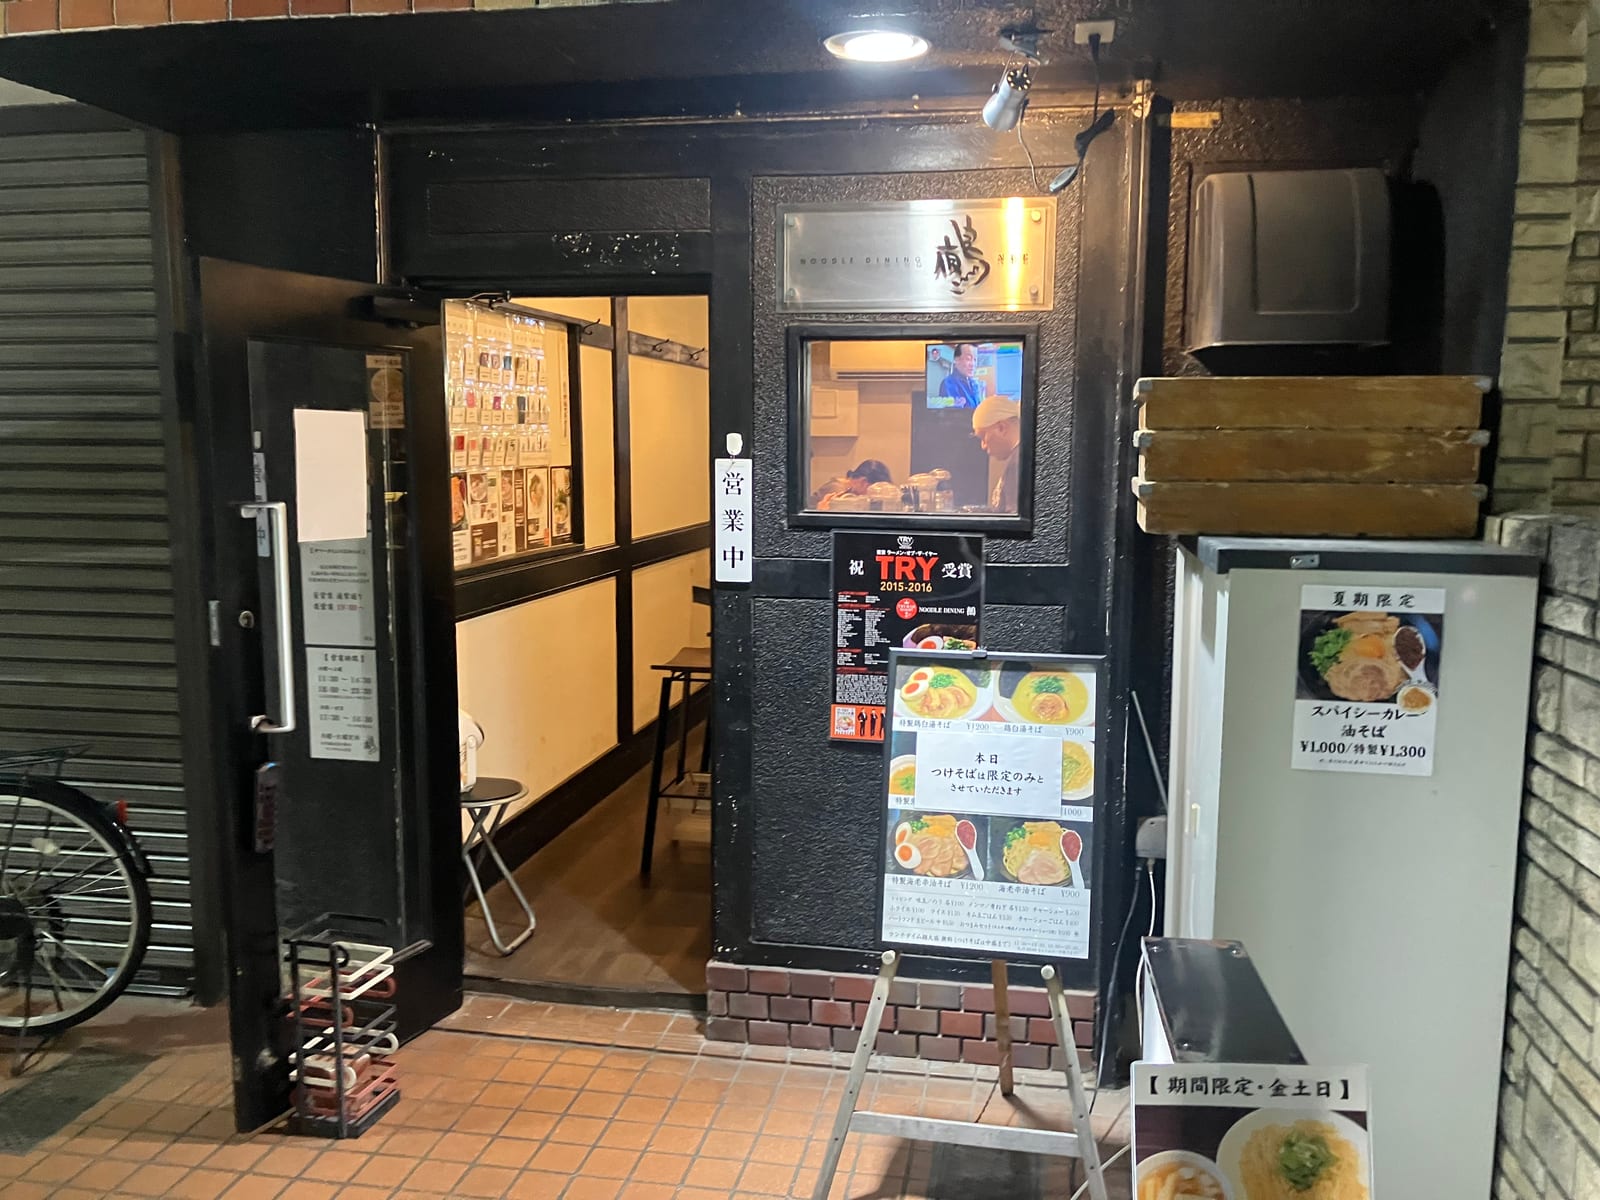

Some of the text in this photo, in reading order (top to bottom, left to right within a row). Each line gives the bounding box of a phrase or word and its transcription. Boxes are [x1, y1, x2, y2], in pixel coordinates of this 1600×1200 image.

[800, 257, 855, 265] NOODLE
[865, 256, 922, 265] DINING
[722, 472, 744, 569] 営業中
[849, 560, 865, 576] 祝
[875, 555, 939, 581] TRY
[941, 562, 973, 579] 受賞
[880, 581, 933, 593] 2015-2016
[1332, 590, 1416, 608] 夏期限定
[1311, 705, 1427, 720] スパイシーカレー
[966, 721, 990, 731] ¥1200
[1065, 727, 1085, 736] ¥900
[1341, 725, 1388, 738] 油そば
[974, 753, 999, 764] 本日
[931, 767, 1045, 784] つけそばは限定のみと
[950, 784, 1022, 796] させていただきます
[960, 881, 984, 891] ¥1200
[1060, 889, 1081, 898] ¥900
